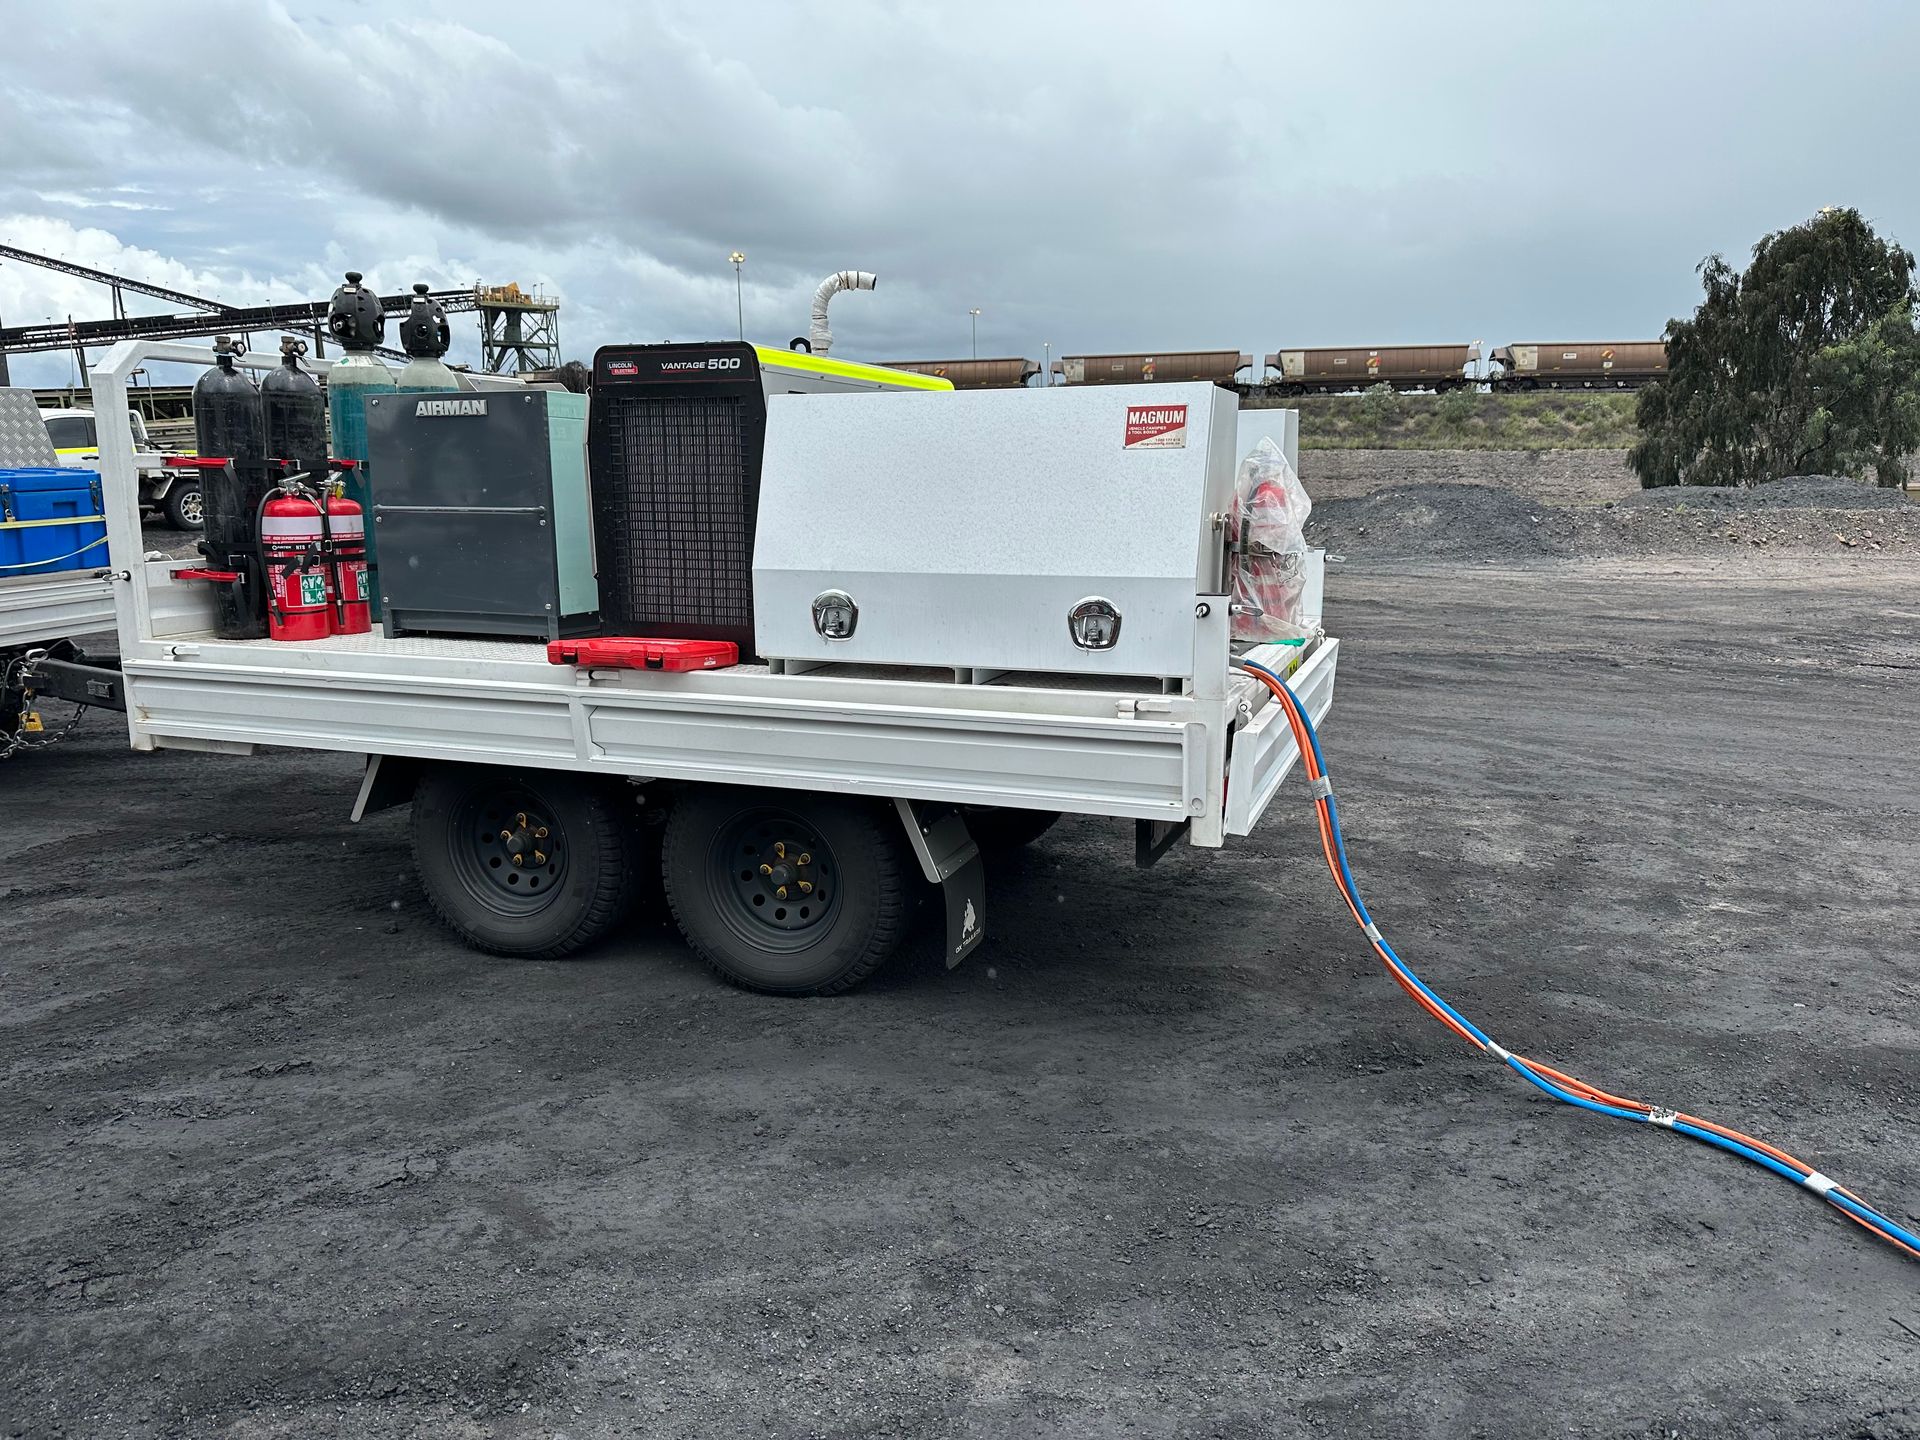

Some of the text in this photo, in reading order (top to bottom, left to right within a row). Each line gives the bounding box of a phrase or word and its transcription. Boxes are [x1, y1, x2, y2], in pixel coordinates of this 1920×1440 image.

[661, 358, 741, 370] VANTAGE 500
[415, 400, 488, 416] AIRMAN
[1129, 410, 1185, 425] MAGNUM
